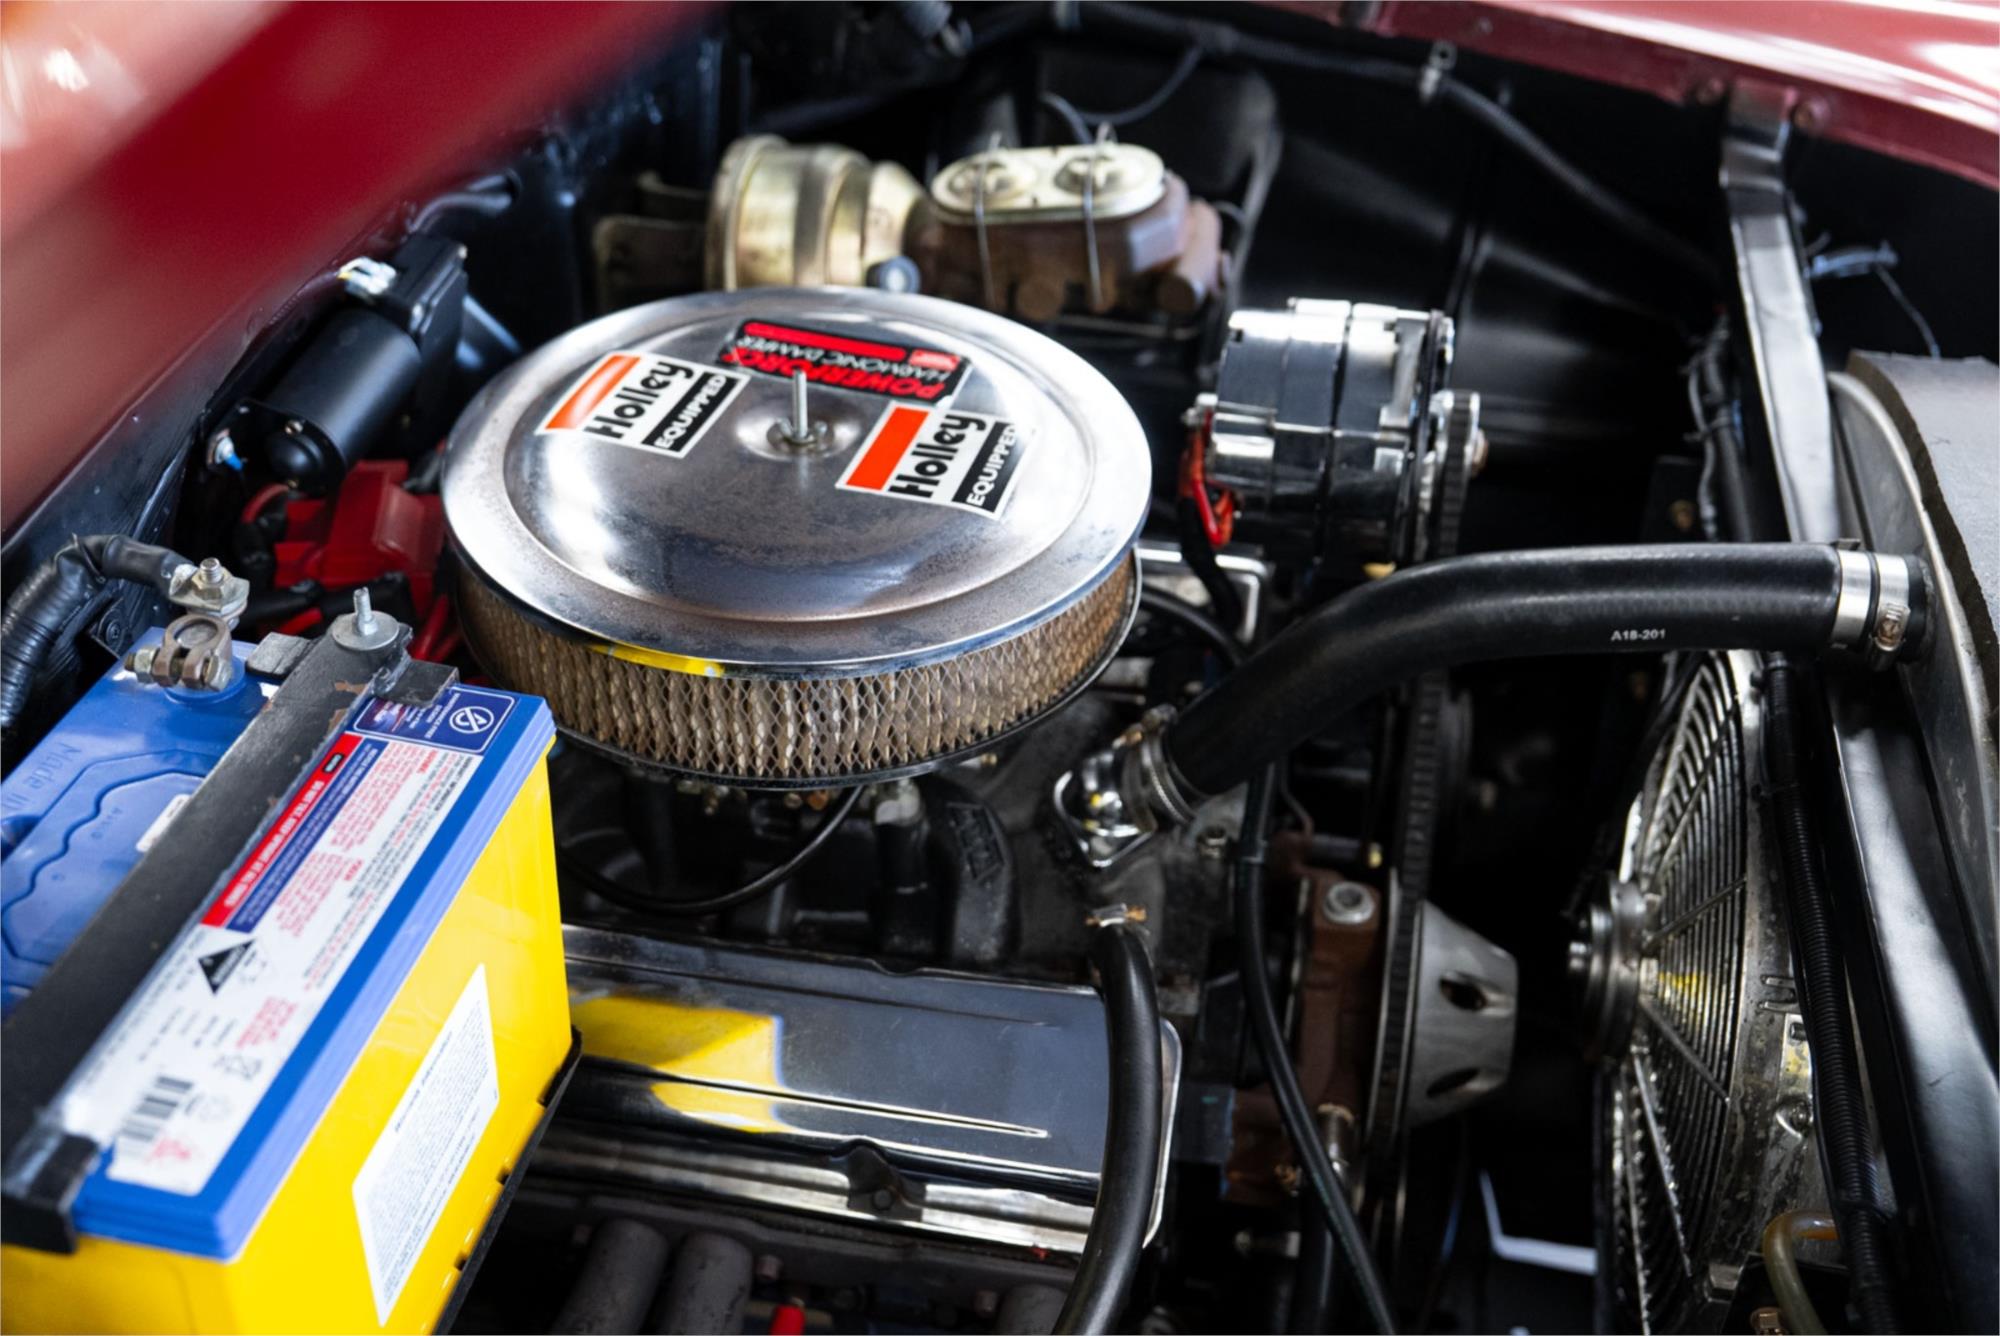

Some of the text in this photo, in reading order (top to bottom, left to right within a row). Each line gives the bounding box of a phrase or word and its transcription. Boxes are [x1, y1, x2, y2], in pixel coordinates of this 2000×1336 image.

[737, 335, 823, 364] DAMPER
[823, 352, 951, 383] HARMONIC
[584, 361, 694, 439] Holley
[654, 374, 727, 449] EQUIPPED
[888, 414, 987, 498] Holley
